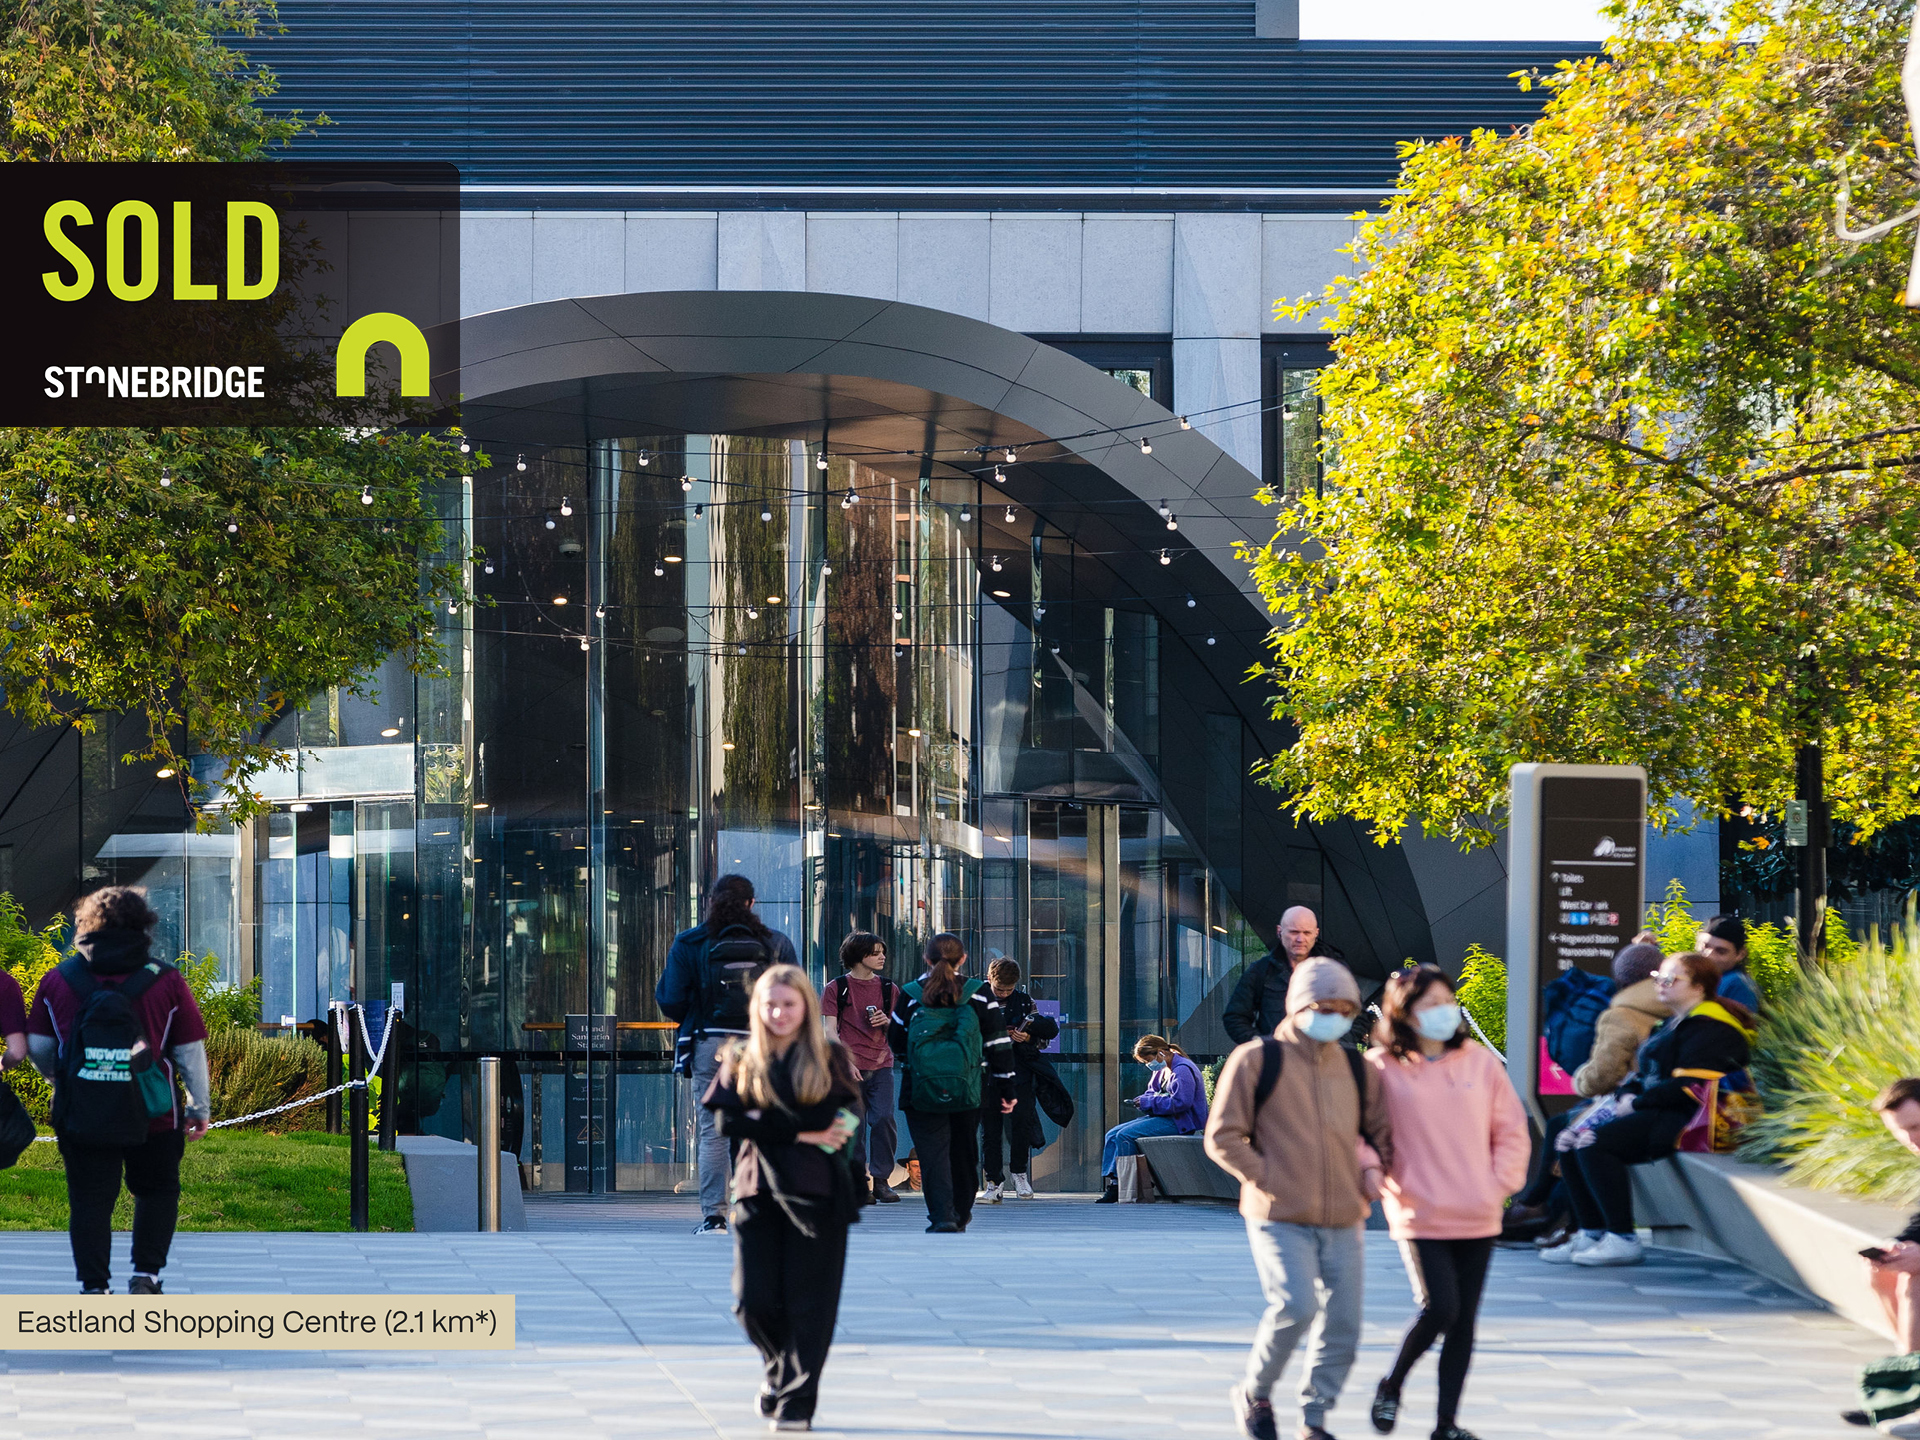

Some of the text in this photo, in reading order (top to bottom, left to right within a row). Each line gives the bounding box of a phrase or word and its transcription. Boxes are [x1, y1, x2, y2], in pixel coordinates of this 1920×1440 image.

[1560, 872, 1585, 883] Toilets
[1559, 900, 1609, 911] West Car ark
[1559, 933, 1619, 946] Ringwood Station
[1558, 947, 1599, 957] Maroondah
[571, 1033, 610, 1041] Saniation
